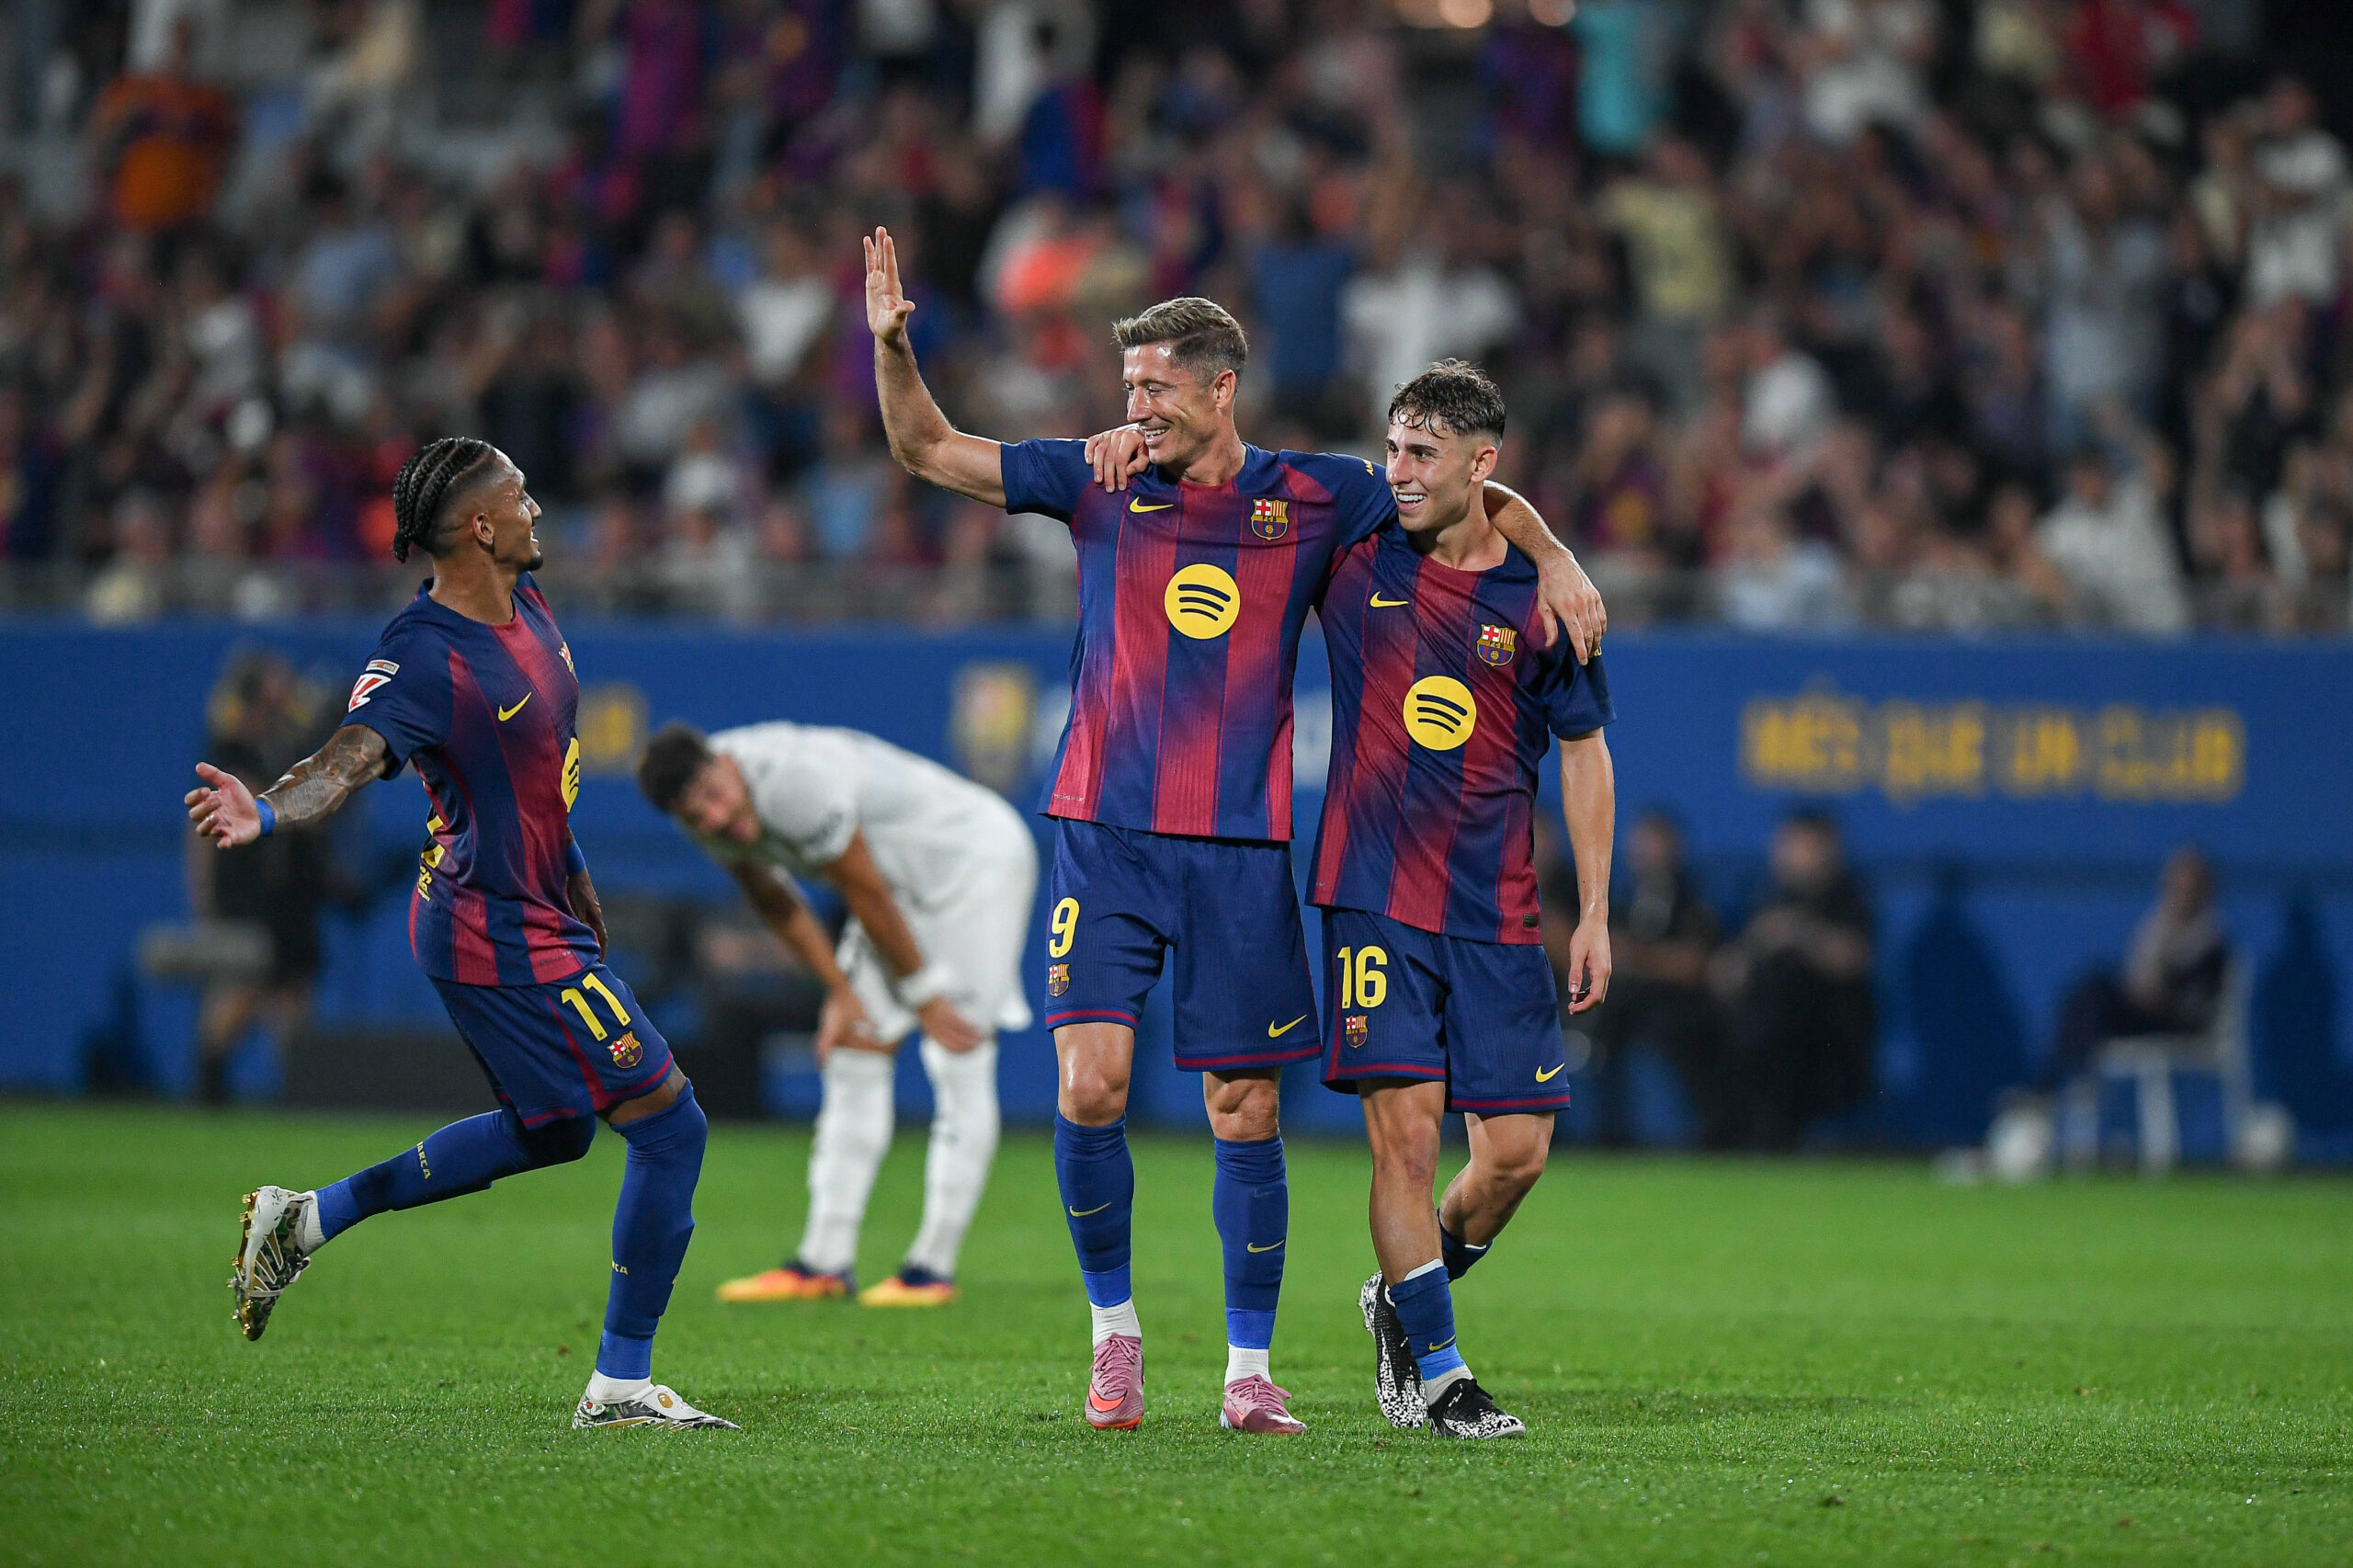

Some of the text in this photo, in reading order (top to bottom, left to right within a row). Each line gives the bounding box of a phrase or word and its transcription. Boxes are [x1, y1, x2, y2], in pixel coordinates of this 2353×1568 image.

[1049, 896, 1080, 959] 9
[561, 971, 631, 1041] 11
[1337, 946, 1388, 1009] 16
